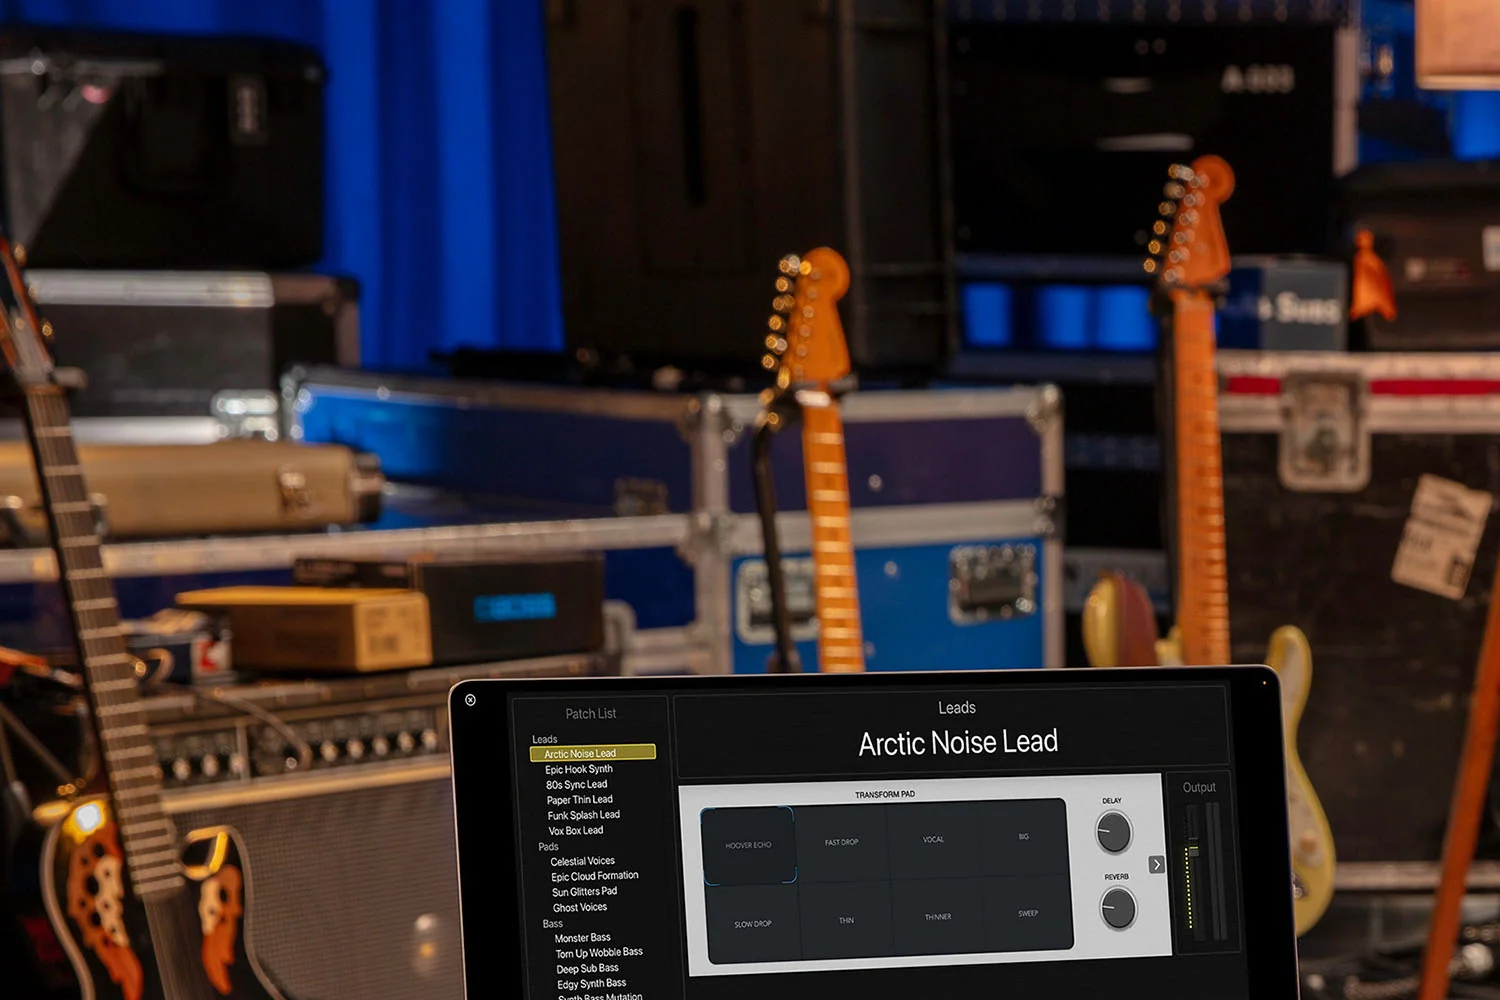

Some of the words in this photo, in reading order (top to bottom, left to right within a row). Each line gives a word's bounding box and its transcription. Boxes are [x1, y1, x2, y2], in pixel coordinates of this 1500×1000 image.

[939, 700, 976, 714] Leads
[566, 708, 596, 720] Patch
[598, 707, 616, 719] List
[532, 734, 558, 744] Leads
[859, 731, 926, 756] Arctic
[932, 730, 997, 754] Noise
[1003, 728, 1058, 753] Lead
[544, 750, 569, 759] Arctic
[570, 749, 594, 758] Noise
[595, 749, 616, 758] Lead
[545, 765, 564, 776] Epic
[564, 765, 588, 774] Hook
[588, 764, 613, 775] Synth
[546, 780, 563, 790] 80s
[564, 780, 586, 791] Sync
[587, 779, 608, 789] Lead
[1183, 782, 1216, 794] Output
[547, 796, 571, 806] Paper
[572, 795, 591, 804] Thin
[592, 794, 613, 804] Lead
[855, 790, 900, 799] TRANSFORM
[900, 790, 916, 798] PAD
[548, 811, 569, 820] Funk
[570, 810, 598, 822] Splash
[600, 810, 620, 819] Lead
[548, 826, 564, 836] Vox
[565, 826, 582, 835] Box
[583, 825, 604, 835] Lead
[1018, 832, 1030, 840] BIG
[725, 841, 753, 850] HOOVER
[753, 841, 772, 849] ECHO
[841, 838, 859, 846] DROP
[922, 836, 944, 844] VOCAL
[538, 842, 559, 851] Pads
[550, 857, 586, 867] Celestial
[587, 856, 616, 865] Voices
[551, 872, 570, 883] Epic
[570, 871, 596, 881] Cloud
[597, 870, 639, 880] Formation
[1104, 873, 1129, 881] REVERB
[552, 888, 569, 897] Sun
[570, 887, 600, 896] Glitters
[601, 886, 618, 895] Pad
[553, 903, 578, 913] Ghost
[579, 902, 608, 912] Voices
[1018, 909, 1039, 917] SWEEP
[542, 919, 564, 928] Bass
[734, 920, 754, 929] SLOW
[753, 919, 772, 928] DROP
[555, 934, 589, 943] Monster
[590, 932, 611, 942] Bass
[556, 949, 574, 959] Torn
[575, 949, 588, 959] Up
[589, 947, 622, 957] Wobble
[622, 946, 643, 956] Bass
[556, 965, 580, 975] Deep
[580, 963, 598, 973] Sub
[599, 963, 620, 972] Bass
[557, 980, 579, 991] Edgy
[580, 979, 605, 990] Synth
[606, 978, 627, 988] Bass
